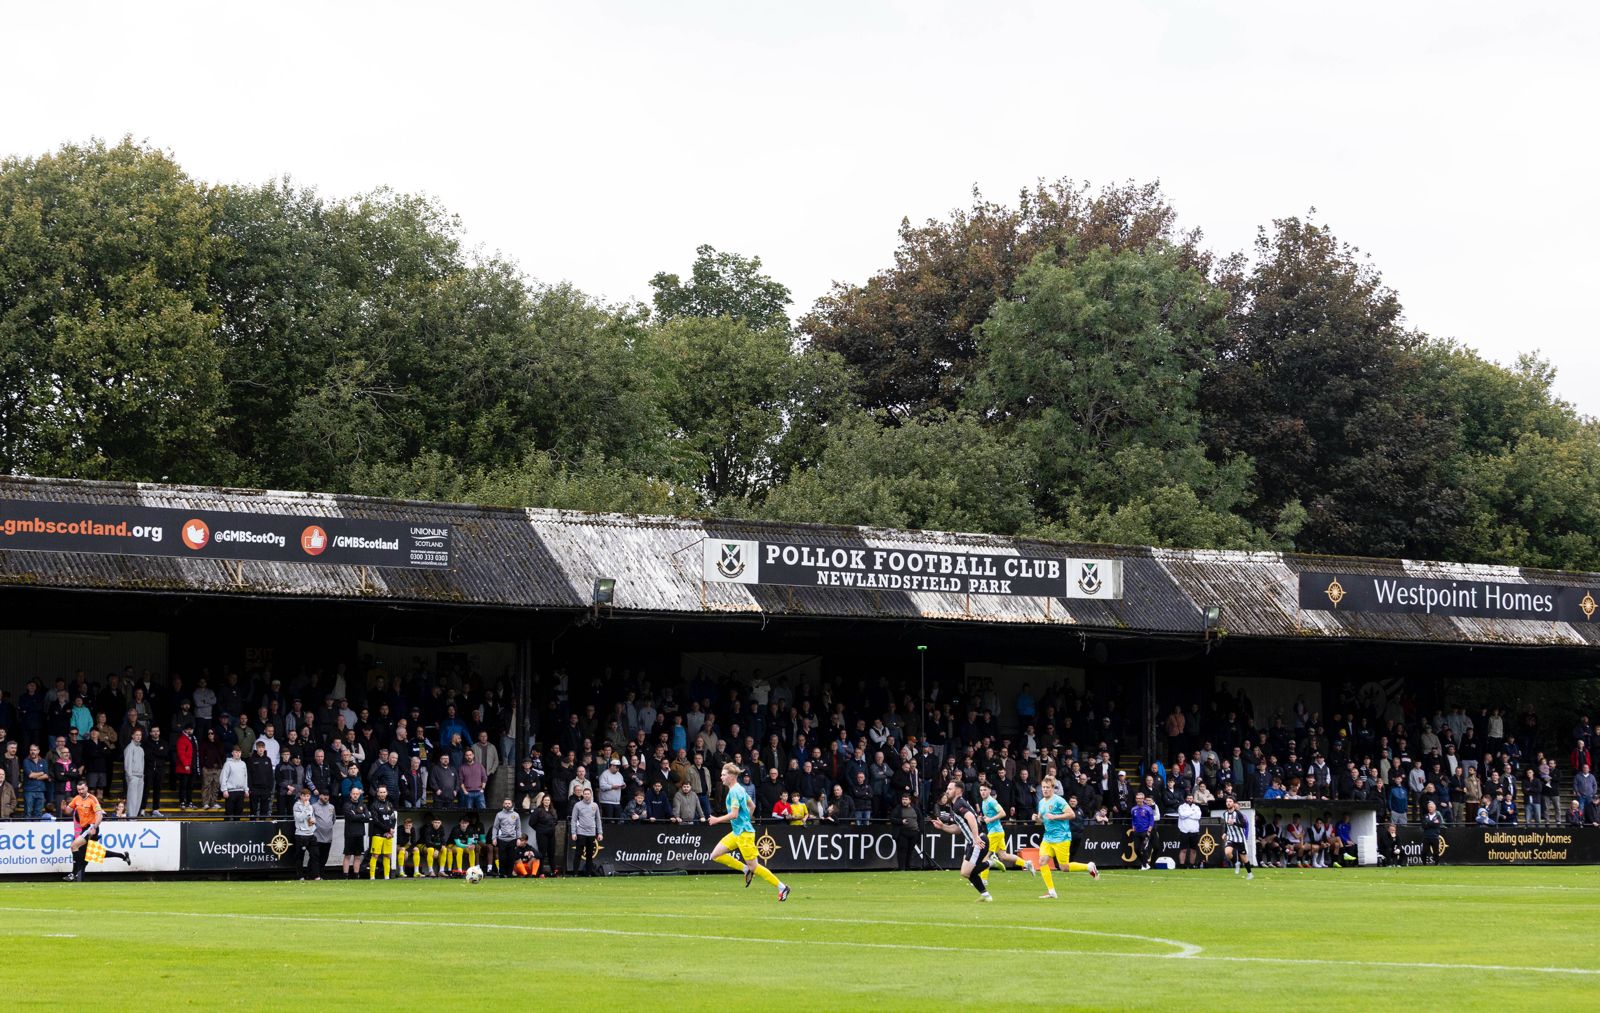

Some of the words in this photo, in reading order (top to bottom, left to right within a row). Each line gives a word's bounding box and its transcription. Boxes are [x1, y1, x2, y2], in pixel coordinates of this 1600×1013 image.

[214, 529, 286, 547] @GMBScotOrg
[410, 527, 448, 537] UNIONLINE
[332, 536, 399, 550] /GMBScotland
[415, 540, 444, 548] SCOTLAND
[766, 544, 866, 570] POLLOK
[873, 550, 997, 576] FOOTBALL
[1004, 558, 1060, 579] CLUB
[817, 570, 961, 592] NEWLANDSFIELD
[969, 579, 1012, 594] PARK
[1373, 579, 1478, 614] Westpoint
[1485, 585, 1553, 612] Homes
[41, 829, 137, 855] glaow
[657, 833, 702, 847] Creating
[788, 833, 941, 860] WESTPONT
[1084, 838, 1098, 850] for
[1100, 841, 1121, 850] over
[1162, 841, 1181, 853] year
[1484, 832, 1517, 846] Building
[1518, 832, 1545, 846] quality
[1545, 832, 1572, 844] homes
[199, 840, 266, 858] Westpoint
[1487, 849, 1533, 862] throughout
[1533, 848, 1567, 860] Scotland
[40, 855, 75, 866] expert
[615, 849, 662, 865] Stunning
